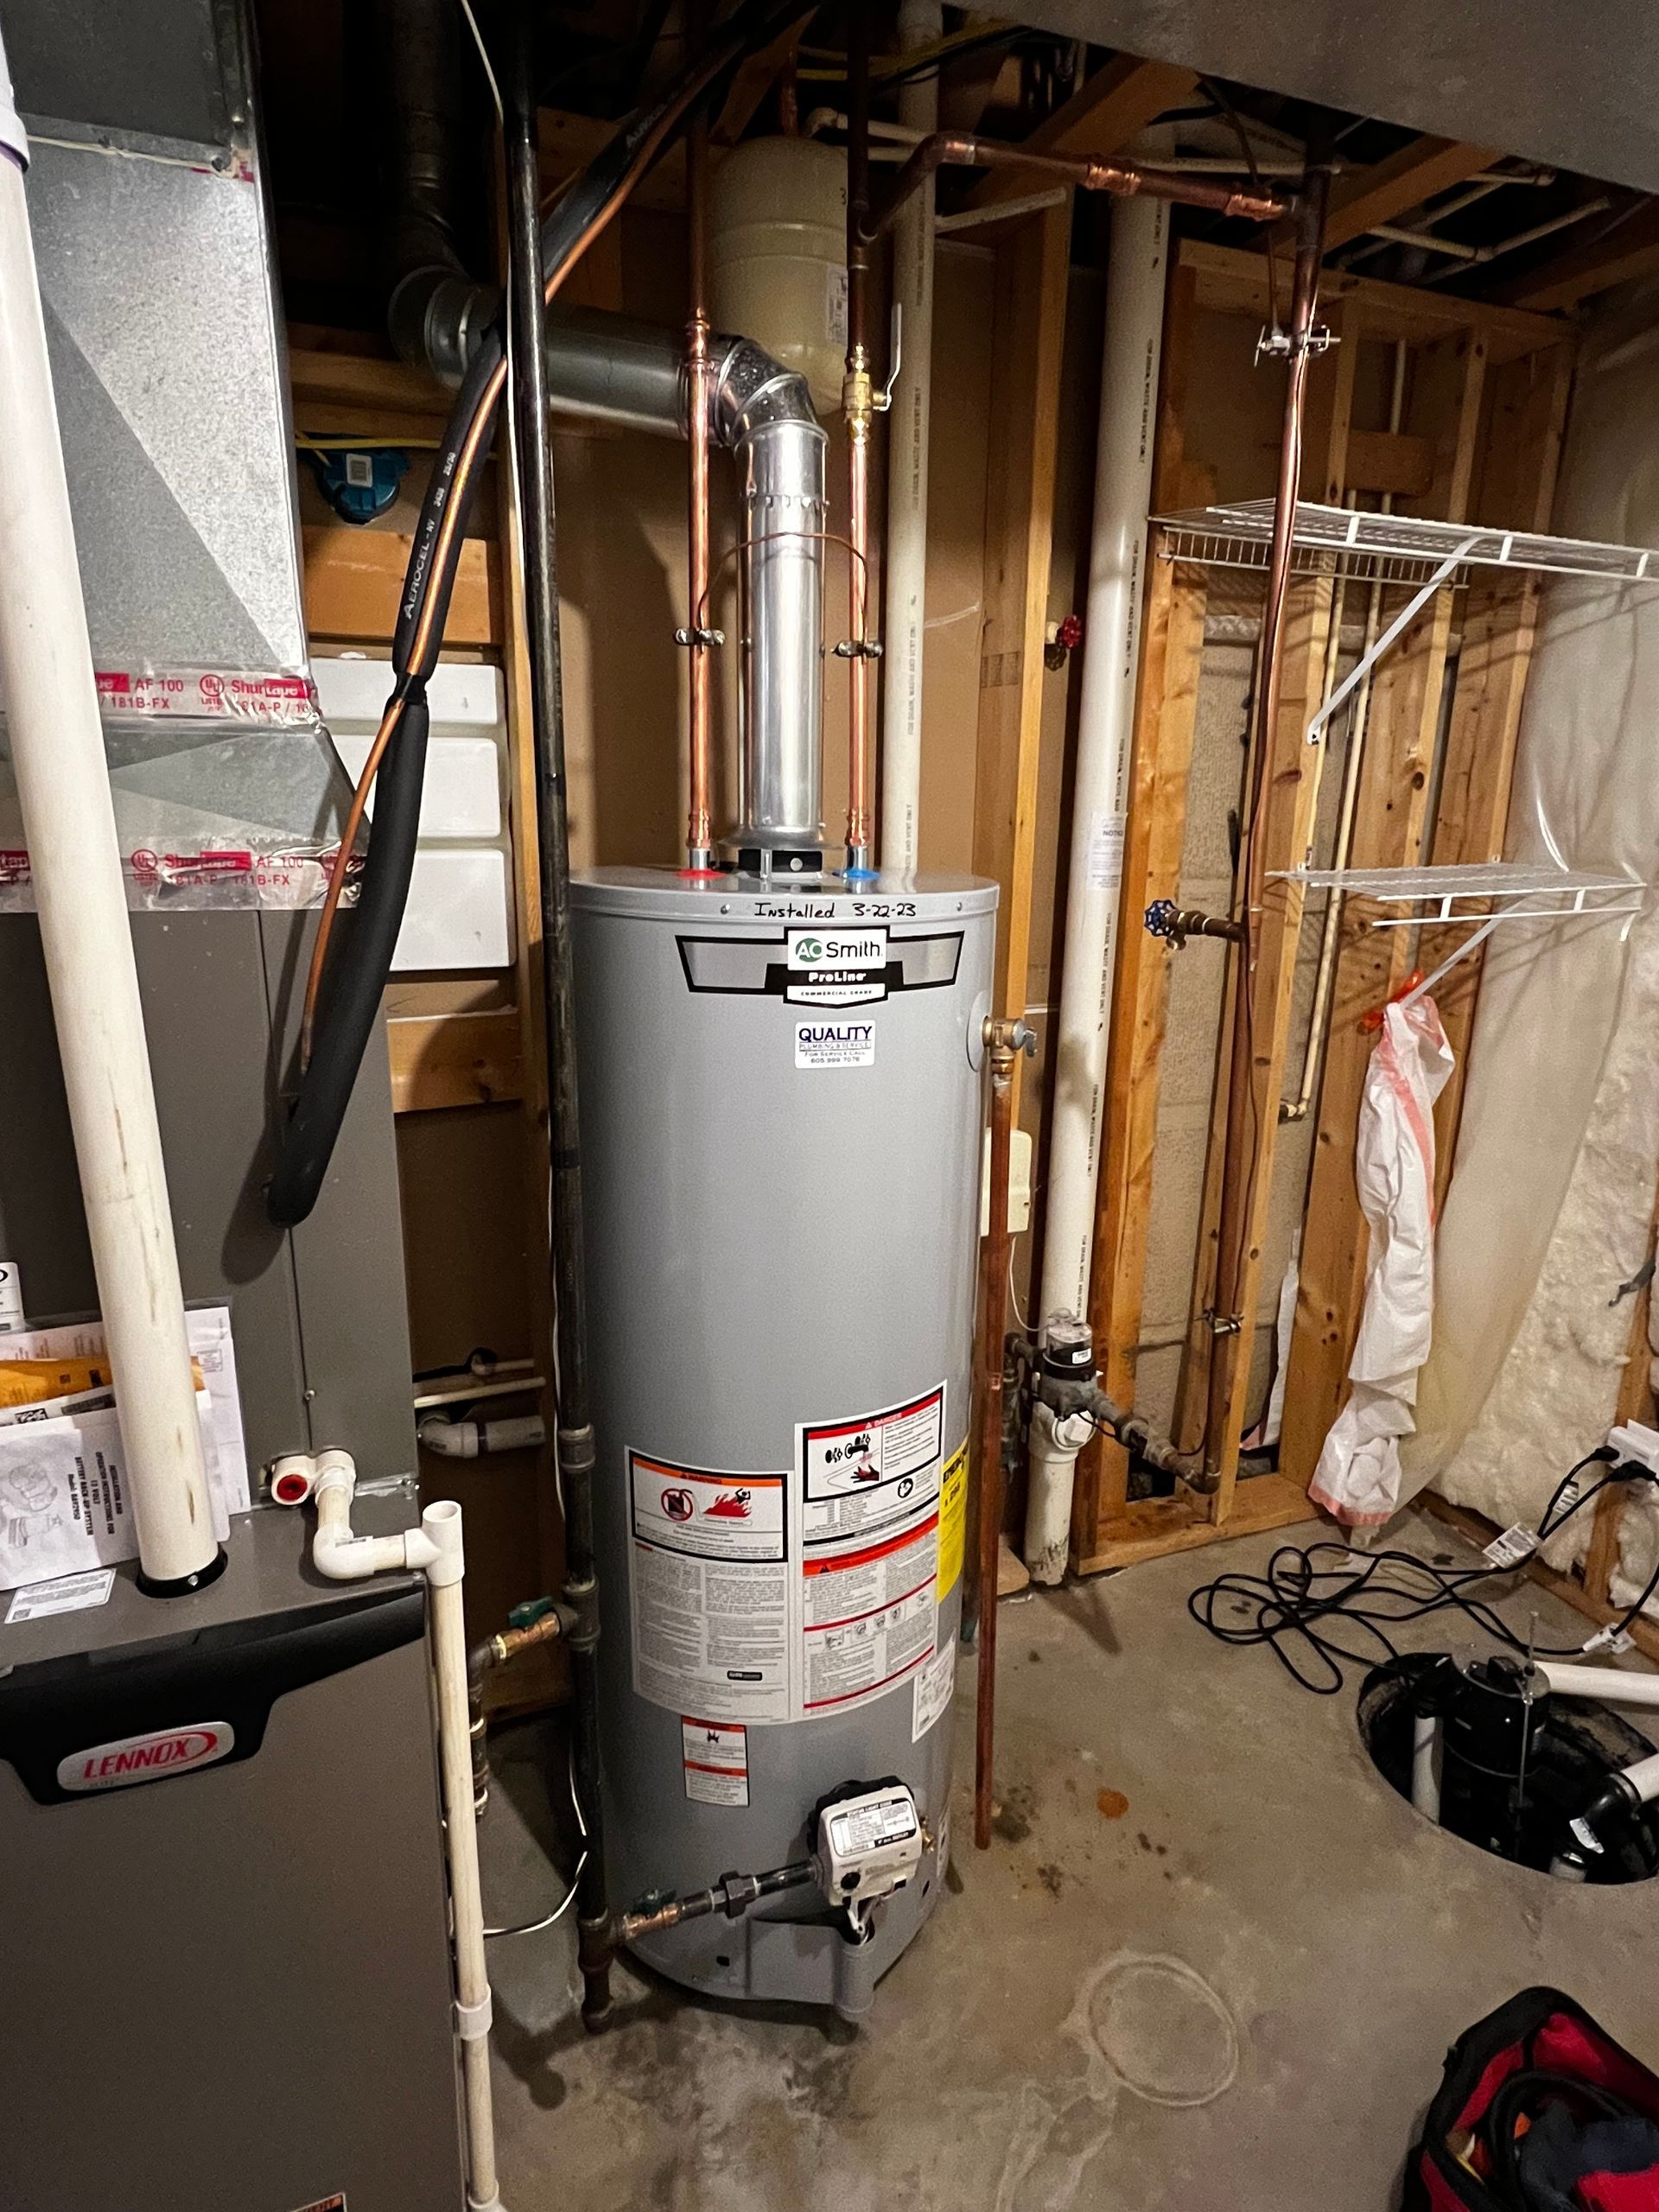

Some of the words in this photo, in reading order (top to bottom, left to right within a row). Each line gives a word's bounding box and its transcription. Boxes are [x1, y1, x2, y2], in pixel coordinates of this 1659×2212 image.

[135, 678, 154, 690] AF
[159, 679, 184, 692] 100
[111, 697, 170, 709] 181B-FX
[257, 855, 273, 868] AF
[281, 856, 303, 868] 100
[754, 902, 835, 918] Installed
[852, 902, 917, 918] 3-22-23
[826, 941, 880, 958] Smith
[808, 971, 867, 982] ProLine
[798, 1026, 872, 1042] QUALITY
[84, 1738, 189, 1780] LENNOX
